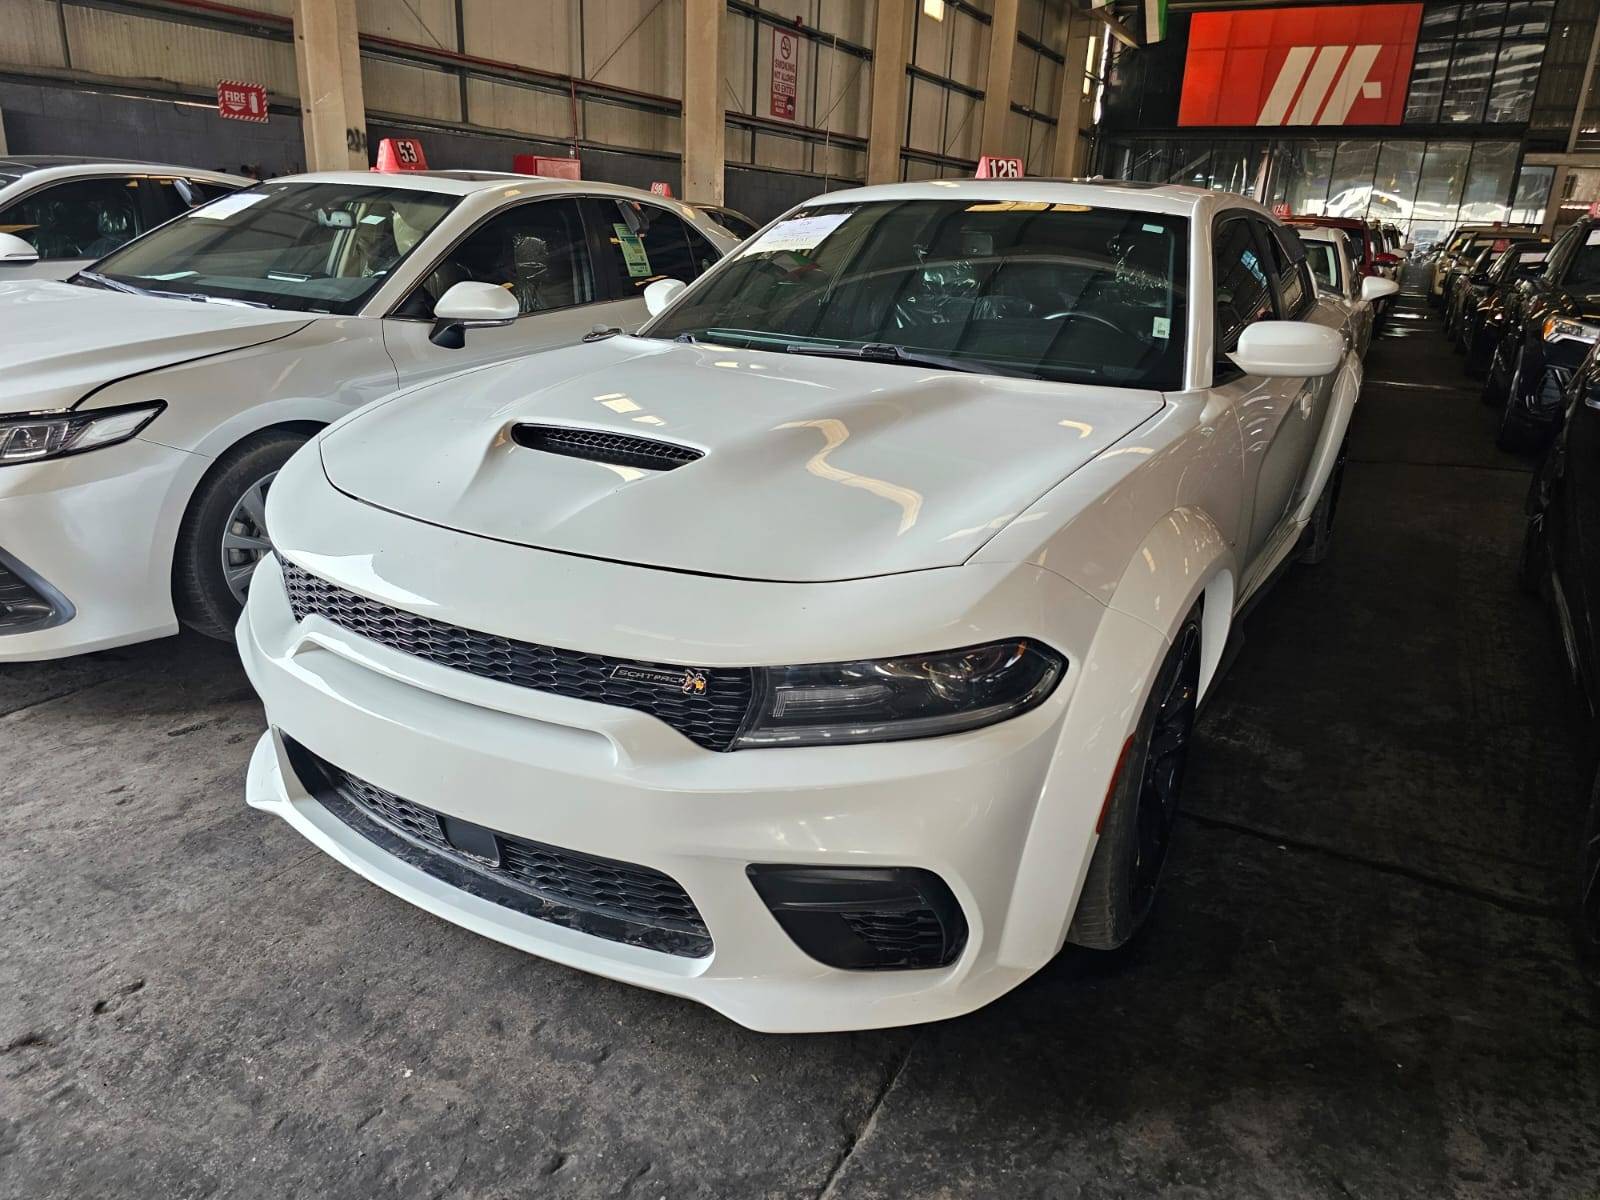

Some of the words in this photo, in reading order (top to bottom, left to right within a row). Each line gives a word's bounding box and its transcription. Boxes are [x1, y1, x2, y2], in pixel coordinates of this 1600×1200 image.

[775, 58, 795, 73] SMOKING
[224, 90, 246, 102] FIRE
[774, 82, 780, 92] NO
[781, 84, 794, 95] ENTRY
[397, 141, 417, 163] 53
[990, 159, 1018, 178] 126
